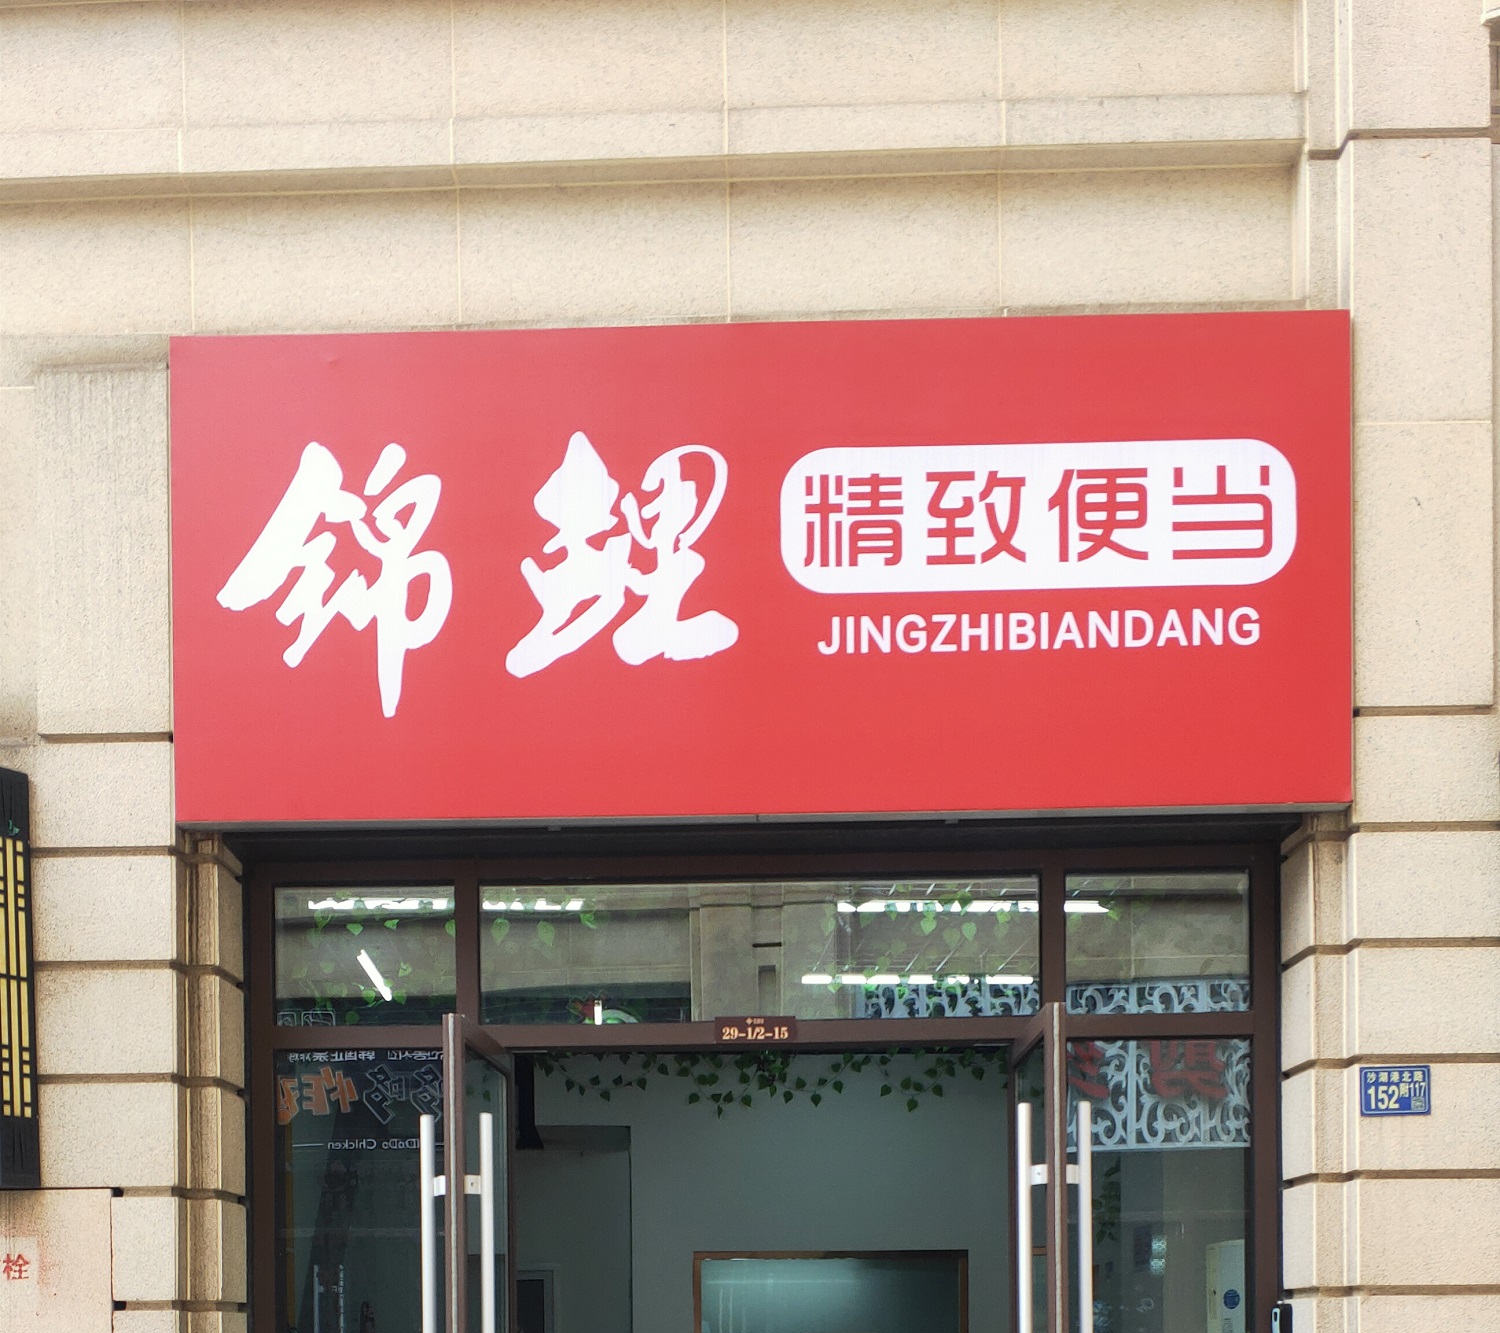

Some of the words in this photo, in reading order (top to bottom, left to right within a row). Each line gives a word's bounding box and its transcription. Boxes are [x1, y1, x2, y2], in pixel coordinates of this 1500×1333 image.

[803, 464, 1273, 568] 精致便当
[817, 606, 1261, 655] JINGZHIBIANDANG
[722, 1026, 789, 1040] 29-1/2-15
[2, 1252, 30, 1281] 栓
